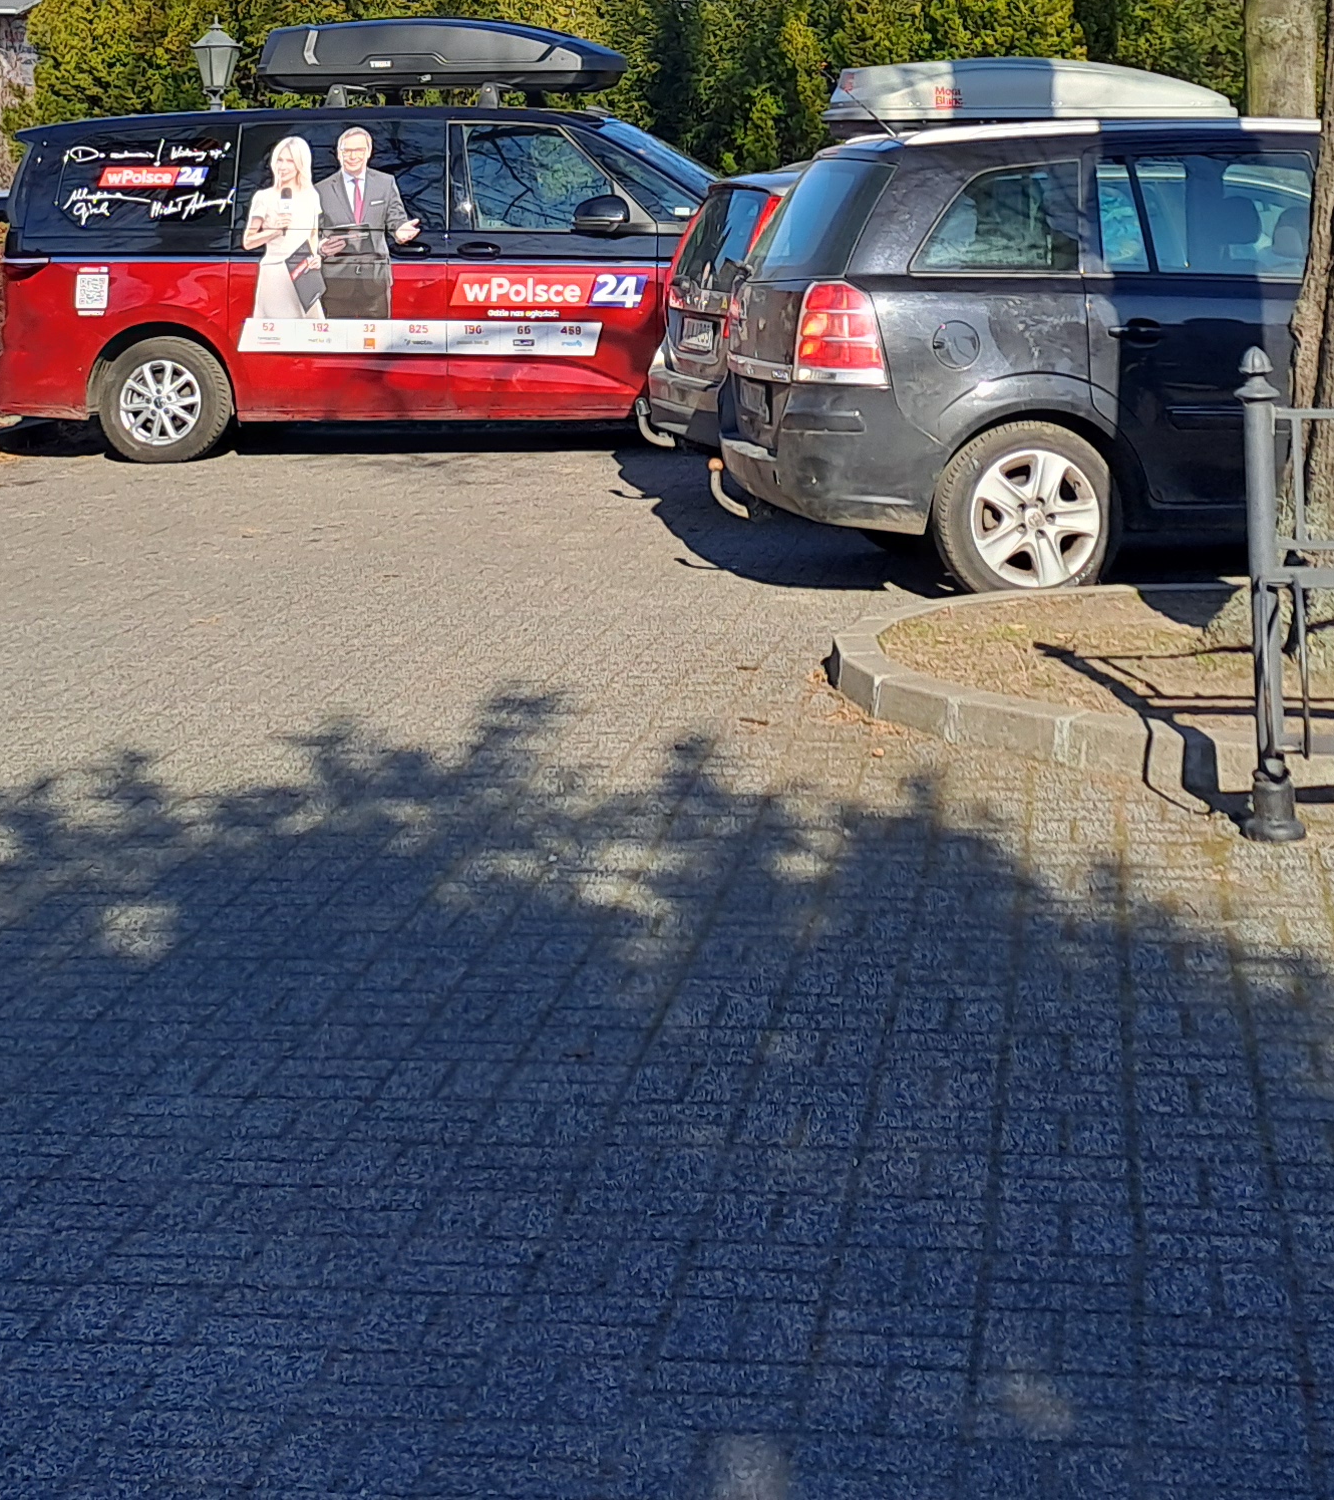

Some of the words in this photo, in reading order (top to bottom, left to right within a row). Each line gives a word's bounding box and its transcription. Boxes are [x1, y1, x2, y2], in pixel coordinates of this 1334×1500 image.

[107, 169, 173, 184] wPolsce
[177, 167, 205, 186] 24
[463, 277, 582, 303] wPolsce
[591, 274, 643, 308] 24
[262, 322, 275, 332] 52
